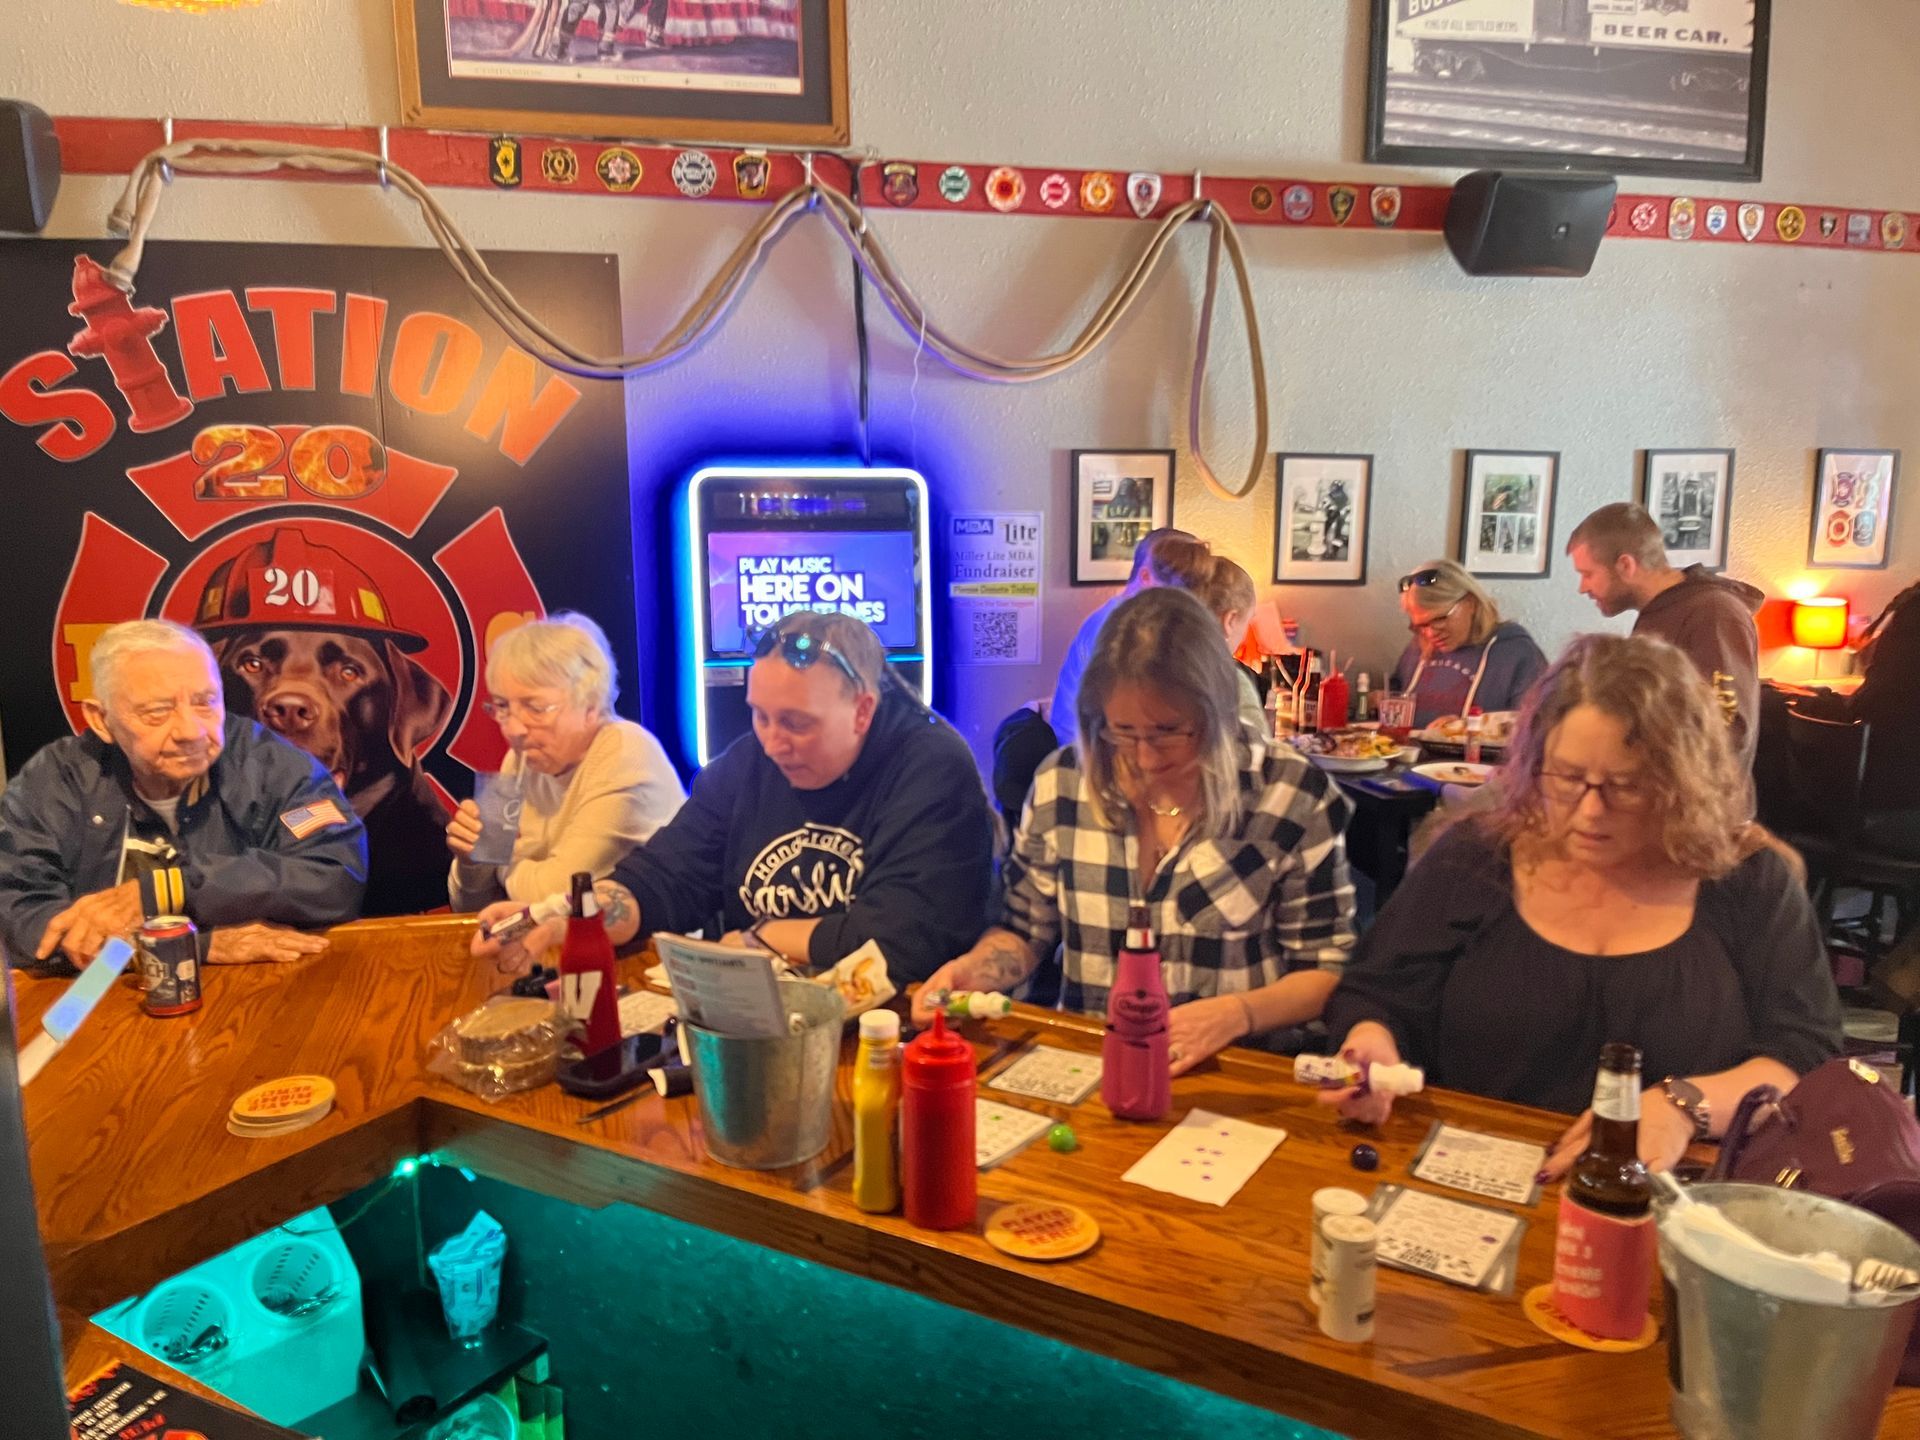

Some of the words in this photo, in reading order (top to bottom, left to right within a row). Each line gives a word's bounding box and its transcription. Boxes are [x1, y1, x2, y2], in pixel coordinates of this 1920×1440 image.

[1603, 23, 1668, 40] BEER
[1675, 28, 1728, 45] CAR.
[0, 254, 583, 467] STATION
[191, 424, 388, 500] 20
[955, 520, 992, 534] MDA
[1004, 523, 1037, 545] Lite
[739, 557, 779, 575] PLAY
[781, 556, 833, 574] MUSIC
[954, 551, 984, 561] Miller
[987, 552, 1005, 561] Lite
[1008, 552, 1034, 561] MDA
[954, 563, 1035, 578] Fundraiser
[264, 568, 320, 607] 20
[740, 575, 811, 603] HERE
[815, 573, 864, 601] ON
